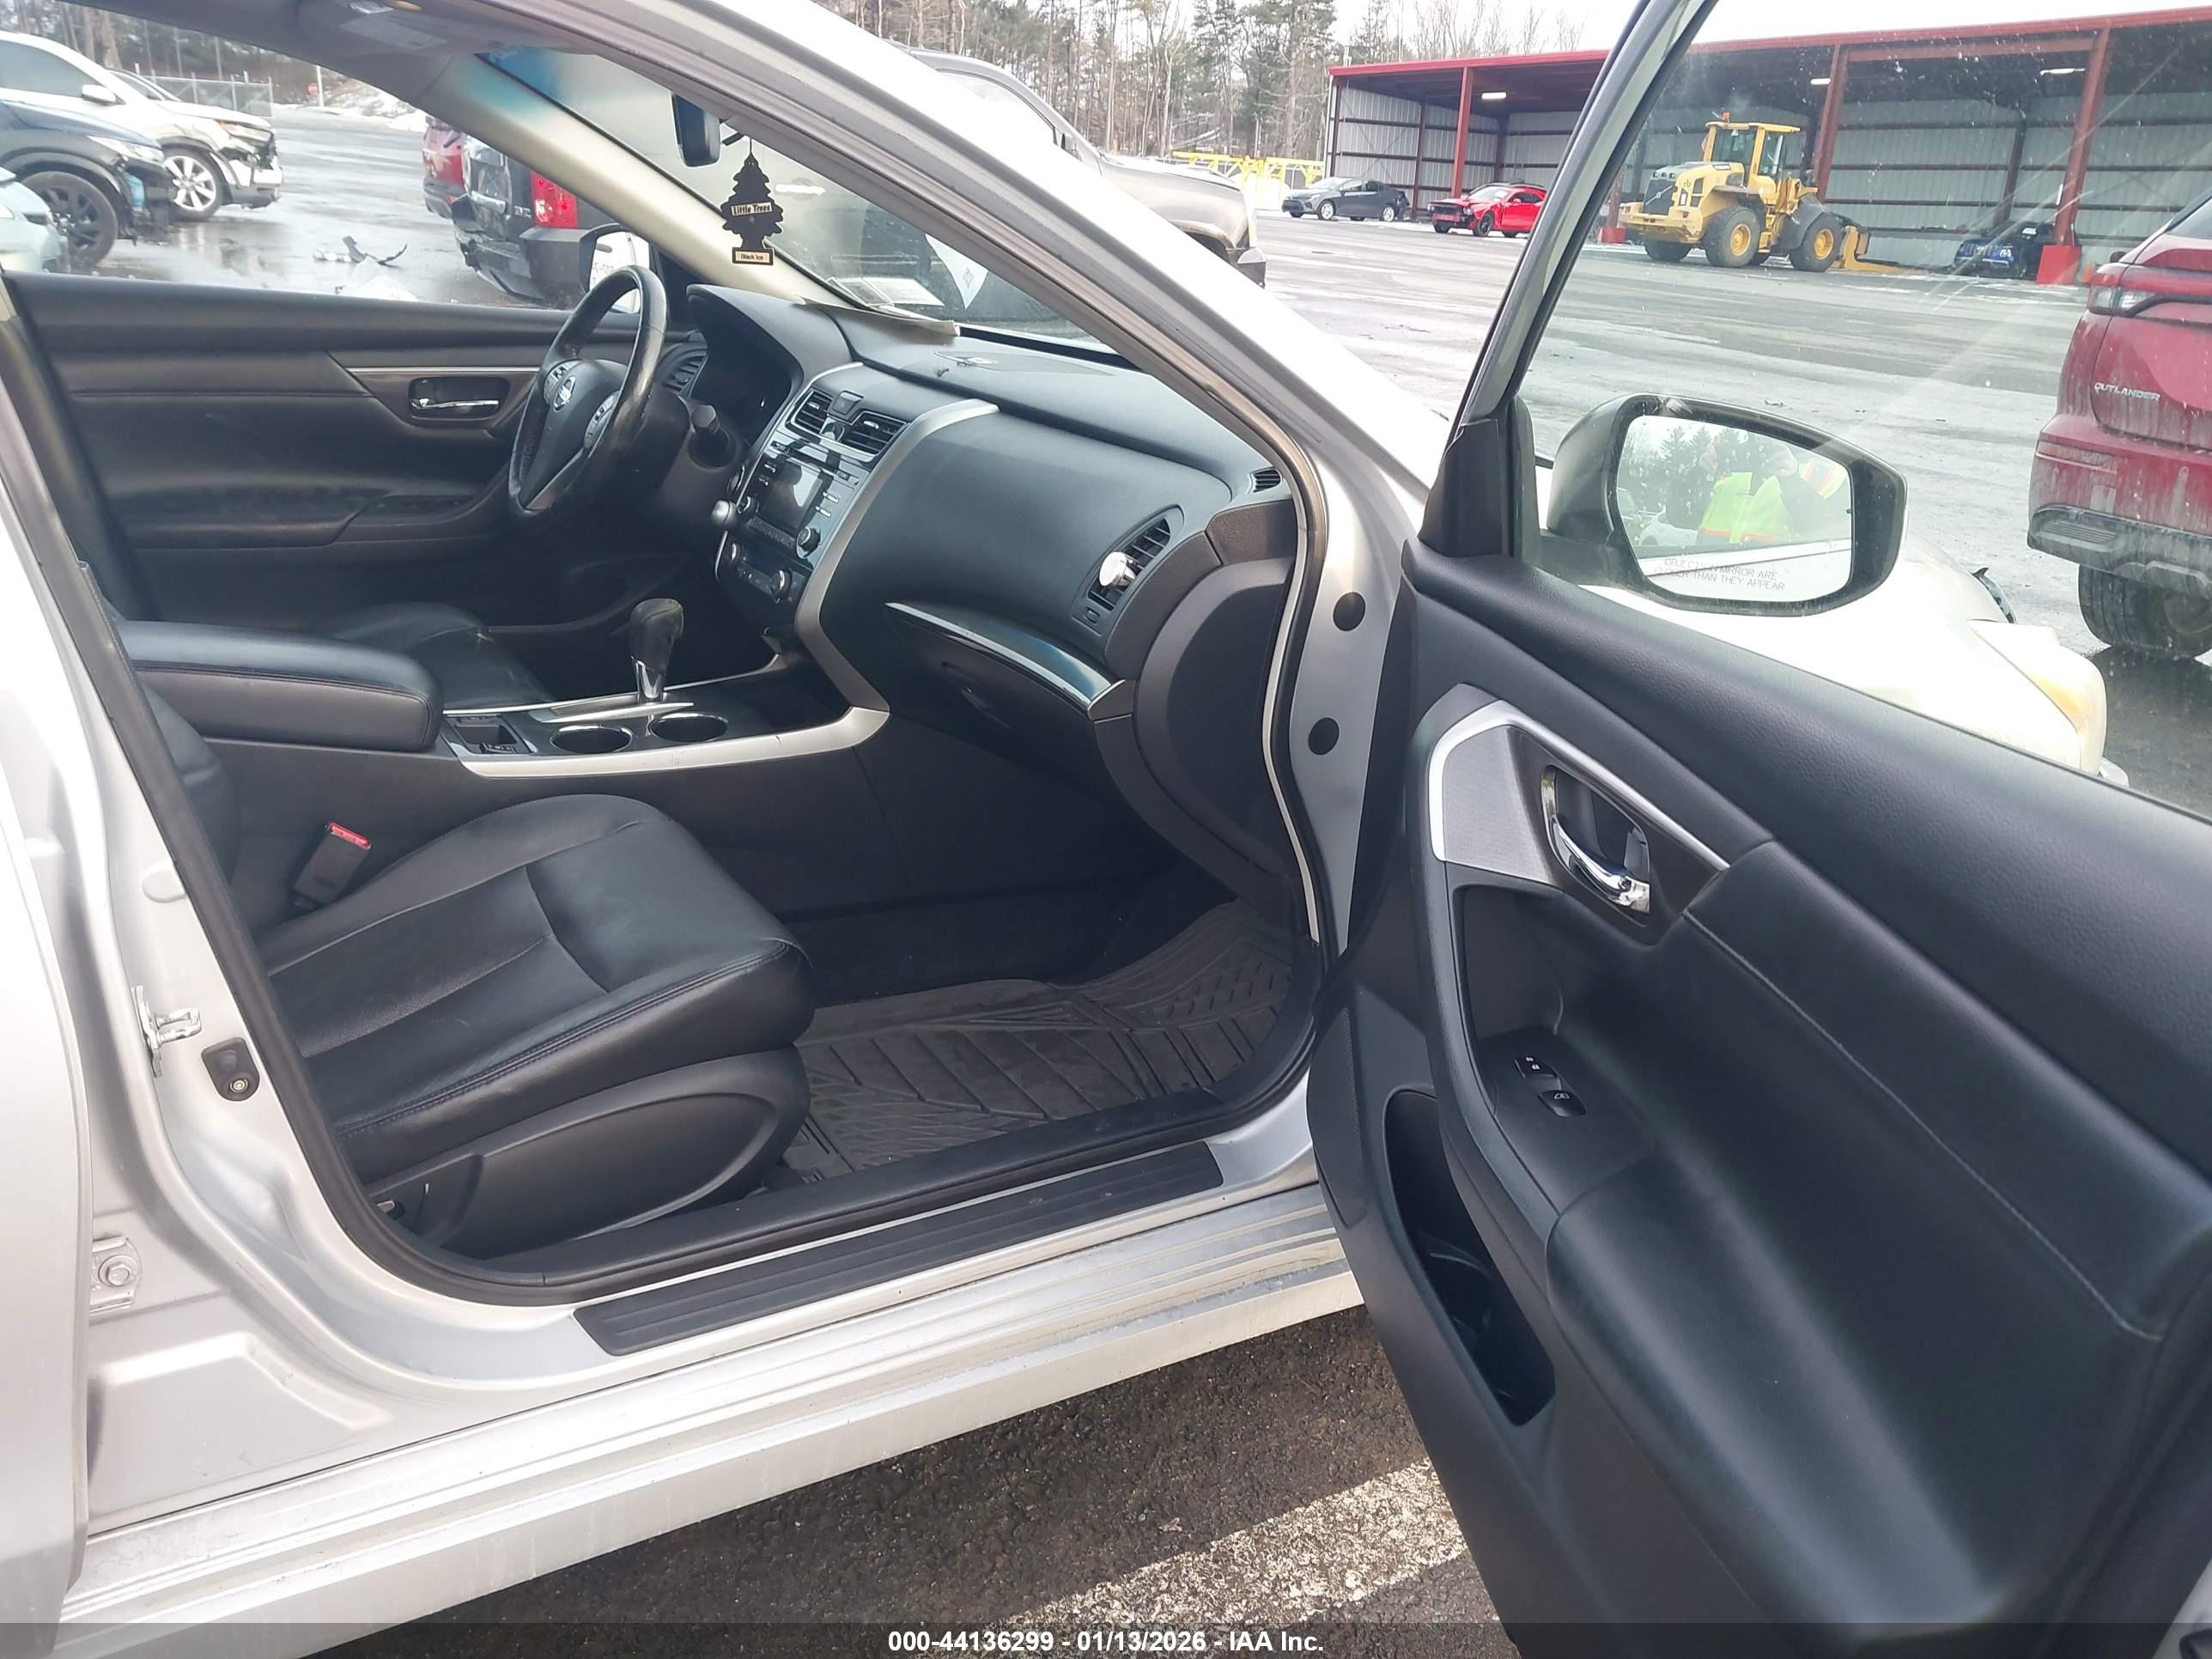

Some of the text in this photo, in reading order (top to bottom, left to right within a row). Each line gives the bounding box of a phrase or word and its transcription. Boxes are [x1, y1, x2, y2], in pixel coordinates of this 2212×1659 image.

[733, 204, 770, 215] Little Trees
[2094, 382, 2160, 400] OUTLANDER
[1720, 566, 1756, 576] MIRROR
[1758, 570, 1778, 580] ARE
[1692, 571, 1717, 583] THAN
[1720, 575, 1744, 586] THEY
[1748, 579, 1785, 592] APPEAR
